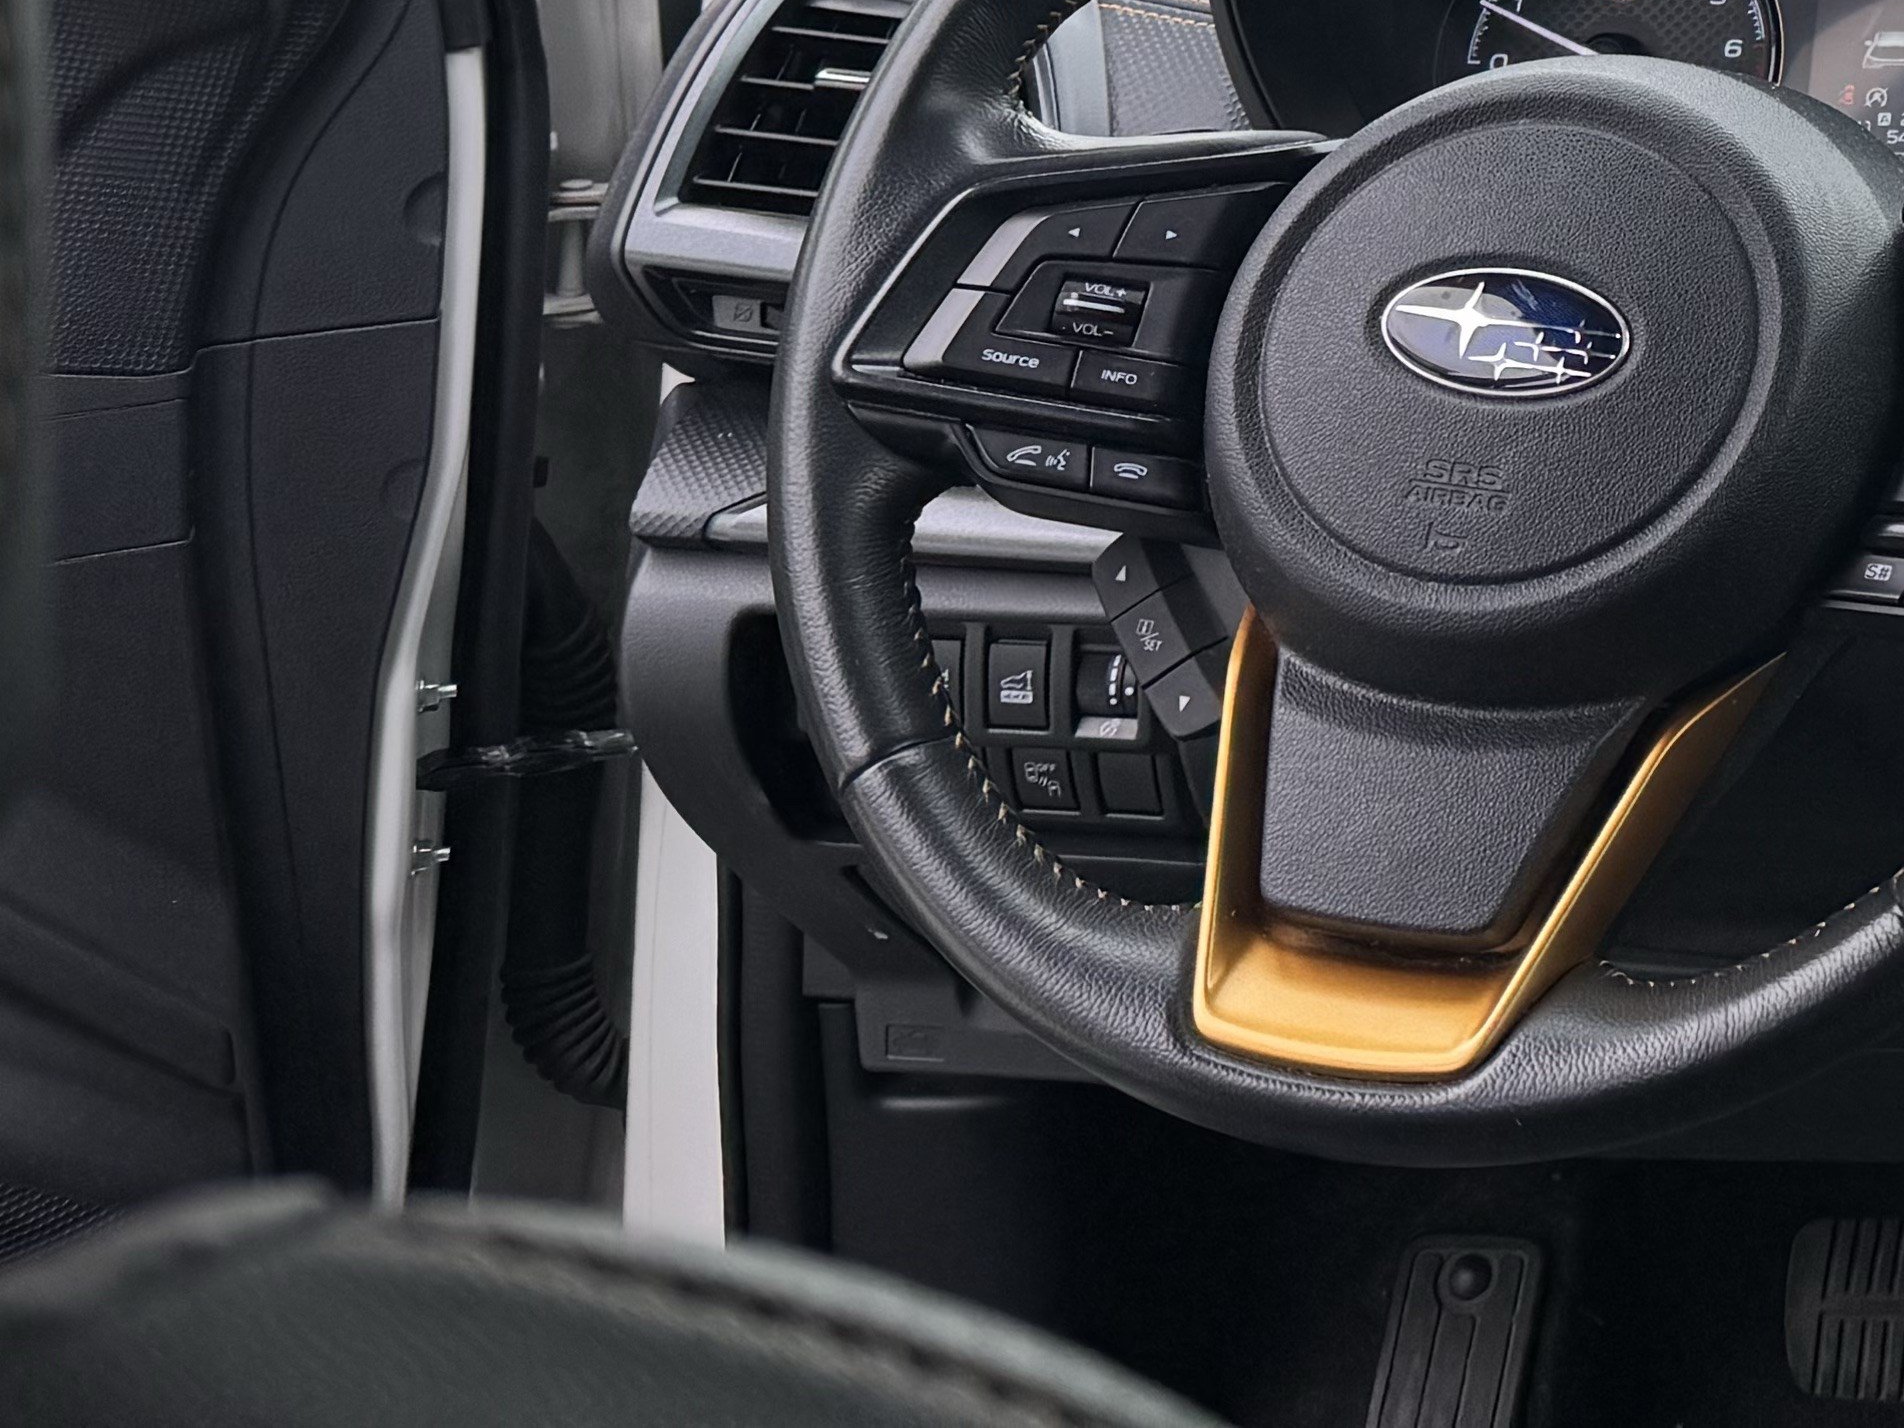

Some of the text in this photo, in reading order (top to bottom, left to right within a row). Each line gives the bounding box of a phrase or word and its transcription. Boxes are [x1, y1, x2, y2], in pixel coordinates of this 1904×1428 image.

[1724, 39, 1743, 58] 6
[981, 348, 1040, 370] Source
[1100, 368, 1138, 387] INFO
[1424, 457, 1503, 486] SRS
[1404, 484, 1509, 512] AIRBAG
